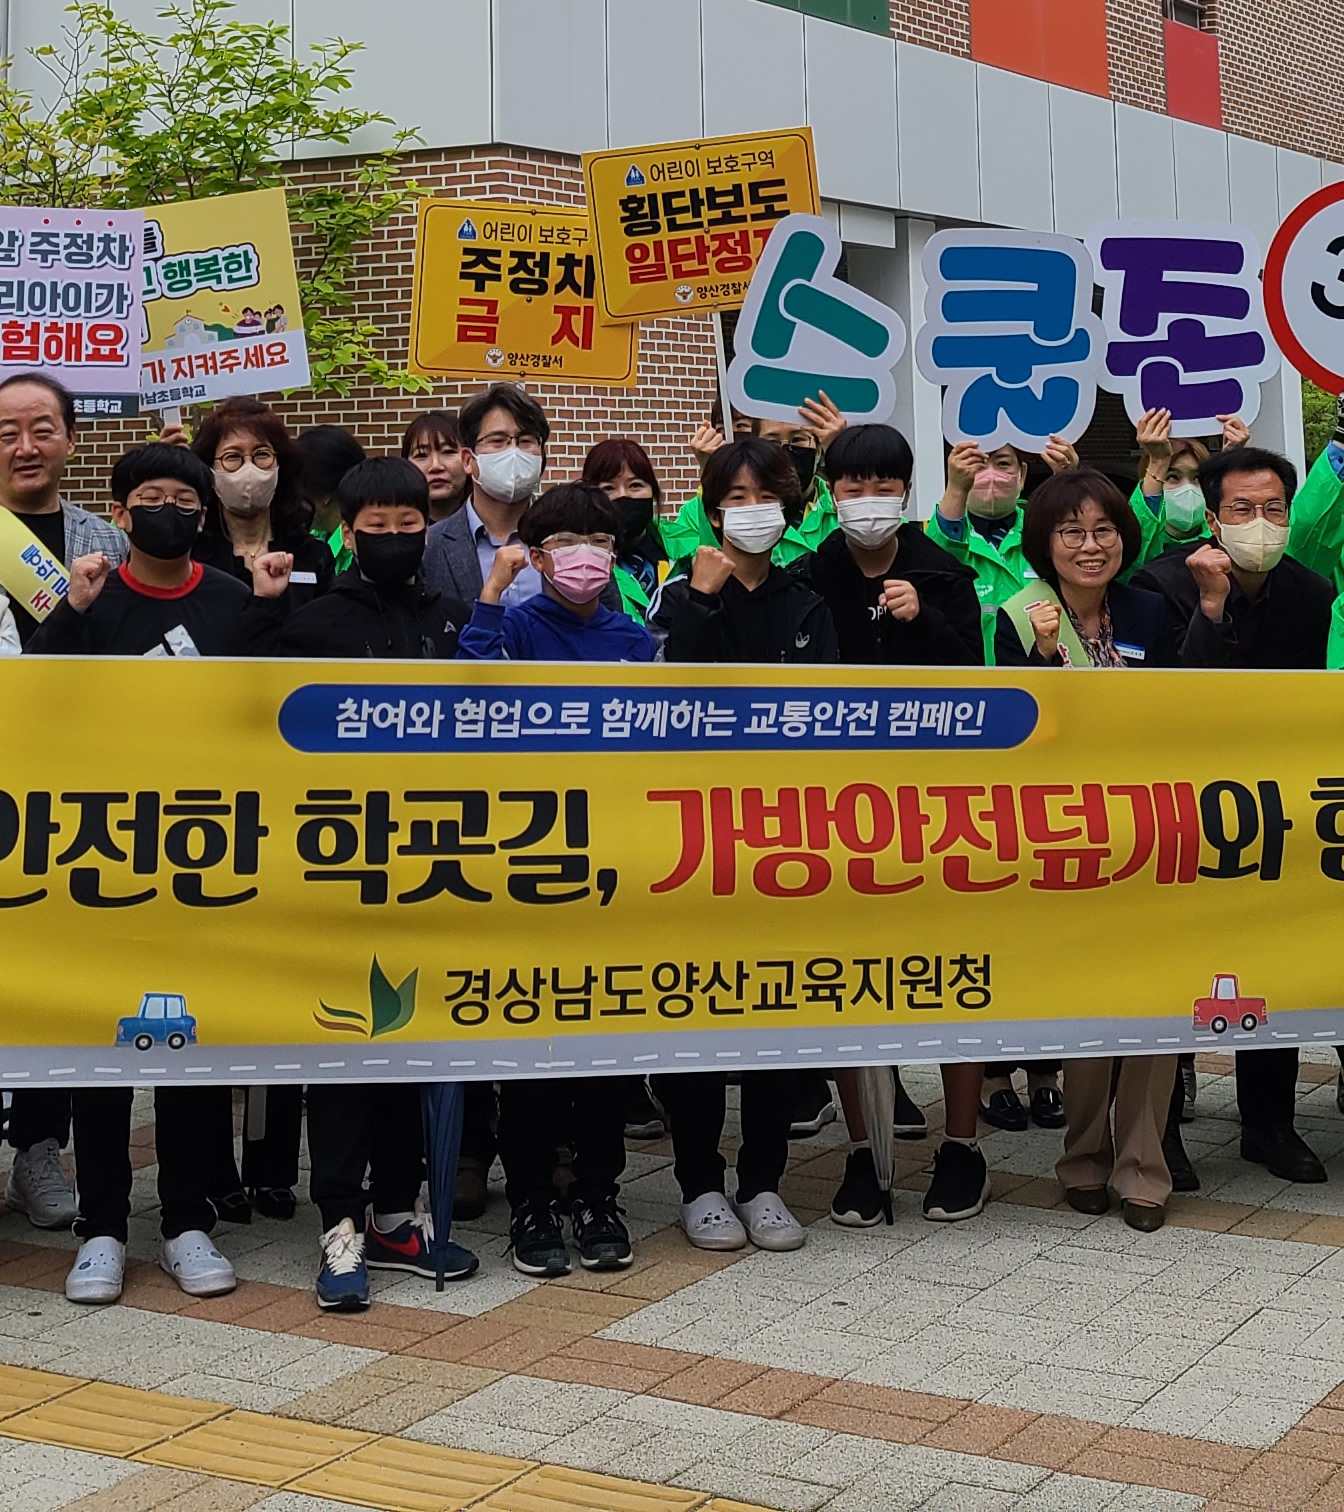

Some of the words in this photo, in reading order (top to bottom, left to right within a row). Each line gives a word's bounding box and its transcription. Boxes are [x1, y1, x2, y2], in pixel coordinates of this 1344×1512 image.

[650, 158, 700, 182] 어린이
[706, 150, 774, 176] 보호구역
[619, 178, 790, 237] 횡단보도
[30, 230, 130, 268] 주정차
[483, 221, 532, 244] 어린이
[538, 225, 589, 248] 보호구
[161, 249, 254, 294] 행복한
[459, 246, 595, 299] 주정차
[171, 341, 289, 381] 지켜주세요
[507, 352, 563, 368] 양산경찰서
[73, 399, 122, 415] 초등학교
[335, 698, 444, 739] 참여와
[454, 698, 592, 739] 협업으로
[601, 698, 737, 738] 함께하는
[744, 700, 878, 737] 교통안전
[887, 699, 986, 737] 캠페인
[294, 788, 618, 907] 학굣길,
[646, 780, 1293, 899] 가방안전덮개와
[443, 954, 993, 1026] 경상남도양산교육지원청
